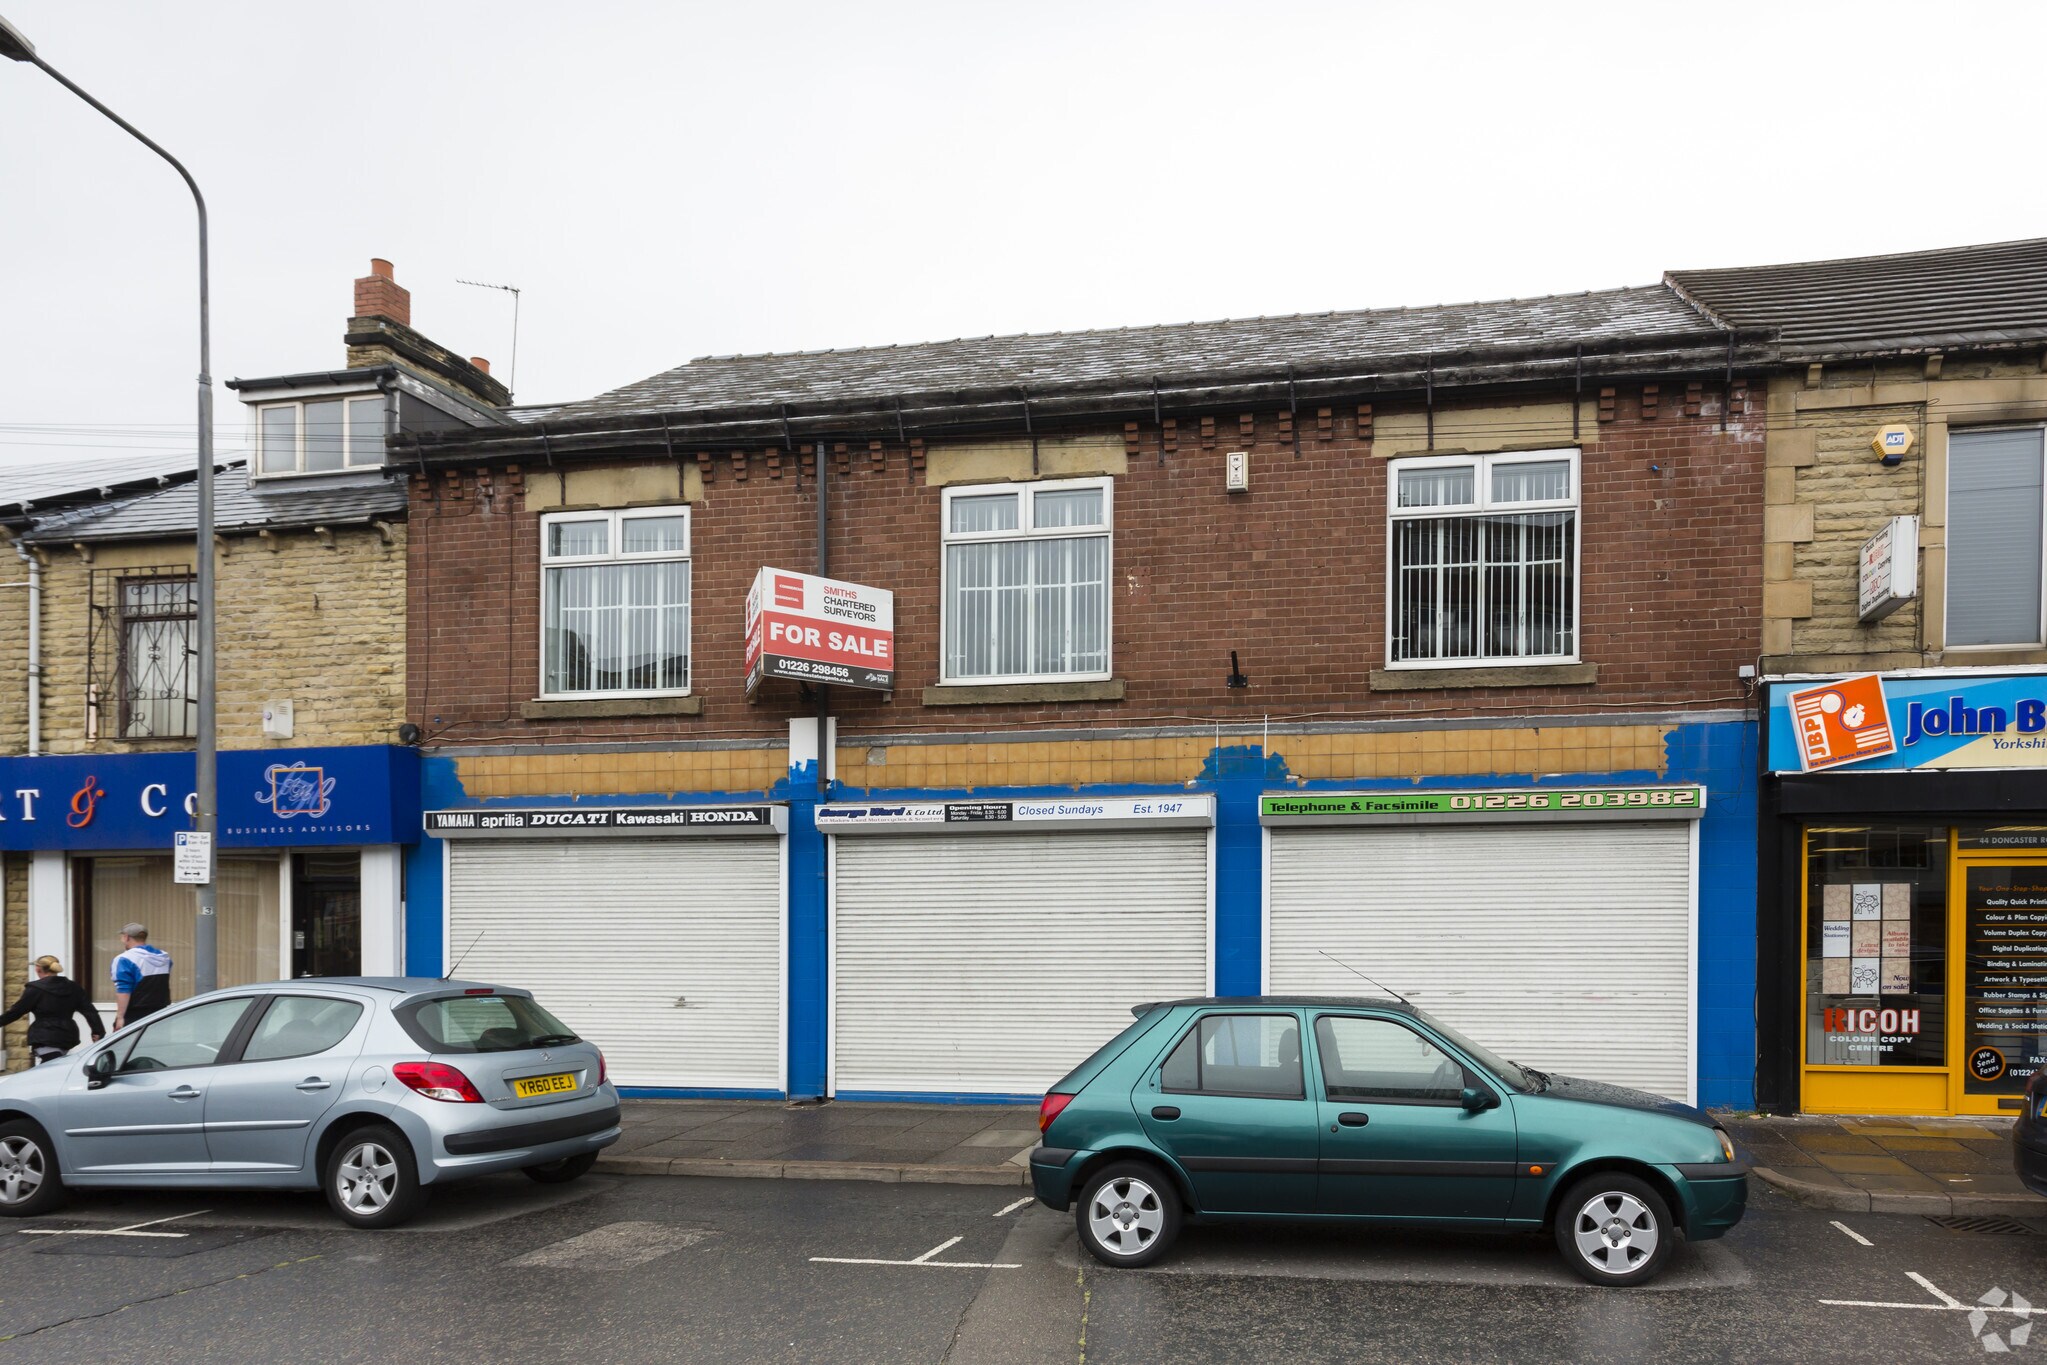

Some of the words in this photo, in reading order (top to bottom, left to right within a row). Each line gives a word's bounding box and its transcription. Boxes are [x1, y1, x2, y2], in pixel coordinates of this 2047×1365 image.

[1886, 434, 1904, 444] ADT
[823, 586, 857, 600] SMITHS
[823, 596, 876, 613] CHARTERED
[823, 605, 876, 622] SURVEYORS
[770, 622, 821, 648] FOR
[828, 632, 888, 658] SALE
[779, 659, 810, 673] 01226
[811, 664, 849, 678] 298456
[1903, 696, 2007, 747] John
[2015, 698, 2047, 735] B
[1804, 718, 1827, 756] JBP
[1992, 737, 2047, 750] Yorkshi
[1820, 757, 1837, 765] much
[1872, 744, 1890, 753] quick
[66, 775, 105, 828] &
[1270, 801, 1346, 814] Telephone
[1350, 802, 1362, 811] &
[1366, 800, 1439, 811] Facsimile
[1450, 793, 1549, 810] 01226
[1560, 791, 1695, 808] 203982
[818, 808, 868, 818] George
[869, 807, 906, 816] Ward
[1018, 806, 1055, 816] Closed
[1057, 805, 1104, 816] Sundays
[1133, 804, 1154, 814] Est.
[1157, 803, 1183, 813] 1947
[436, 814, 475, 827] YAMAHA
[481, 813, 524, 829] aprilia
[530, 813, 609, 825] DUCATI
[616, 812, 684, 825] Kawasaki
[690, 811, 759, 823] HONDA
[226, 827, 294, 835] BUSINESS
[301, 824, 371, 833] ADVISORS
[1998, 1007, 2023, 1015] Supplies
[1823, 1007, 1920, 1034] RICOH
[1979, 1051, 1991, 1059] We
[1977, 1056, 1995, 1068] Send
[1980, 1064, 1999, 1075] Faxes
[520, 1079, 551, 1094] YR60
[551, 1076, 573, 1090] EEJ
